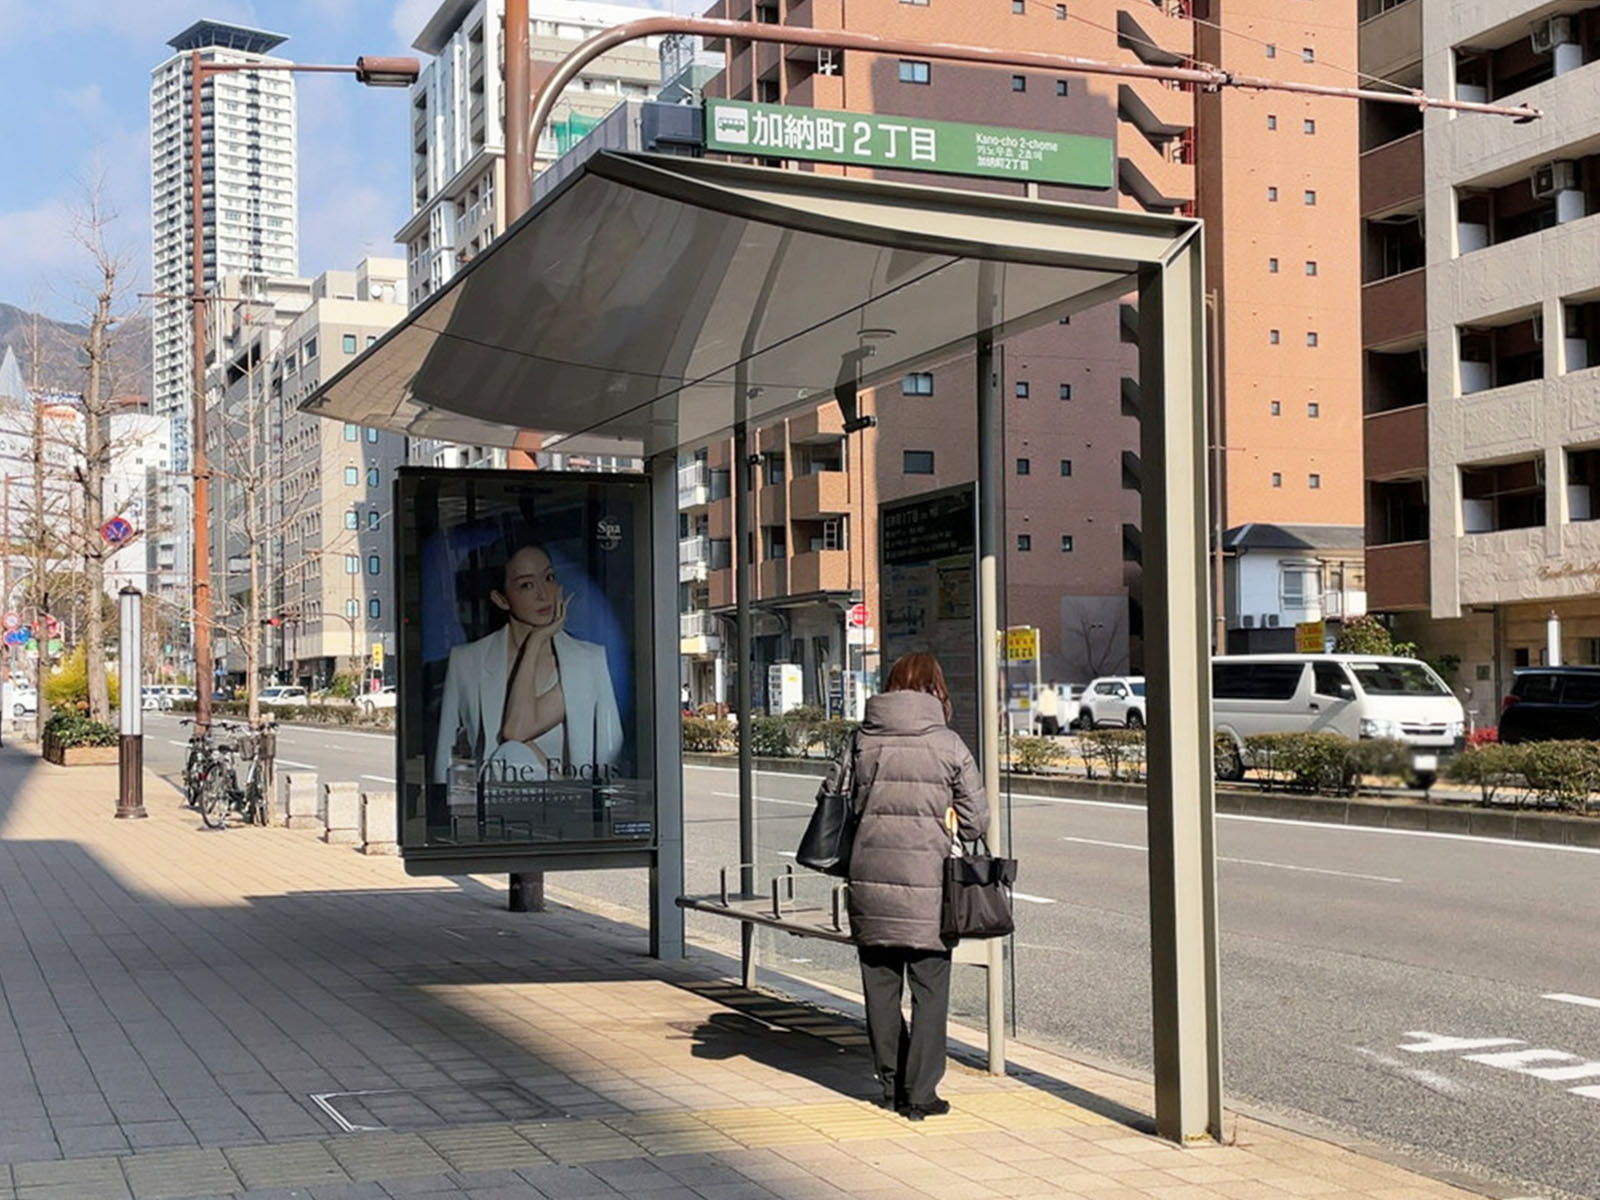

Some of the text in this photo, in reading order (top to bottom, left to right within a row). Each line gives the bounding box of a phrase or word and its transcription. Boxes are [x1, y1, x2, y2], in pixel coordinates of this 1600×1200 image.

[752, 110, 937, 162] 加納町2丁目
[597, 520, 621, 537] Spa
[484, 757, 622, 783] The Focus
